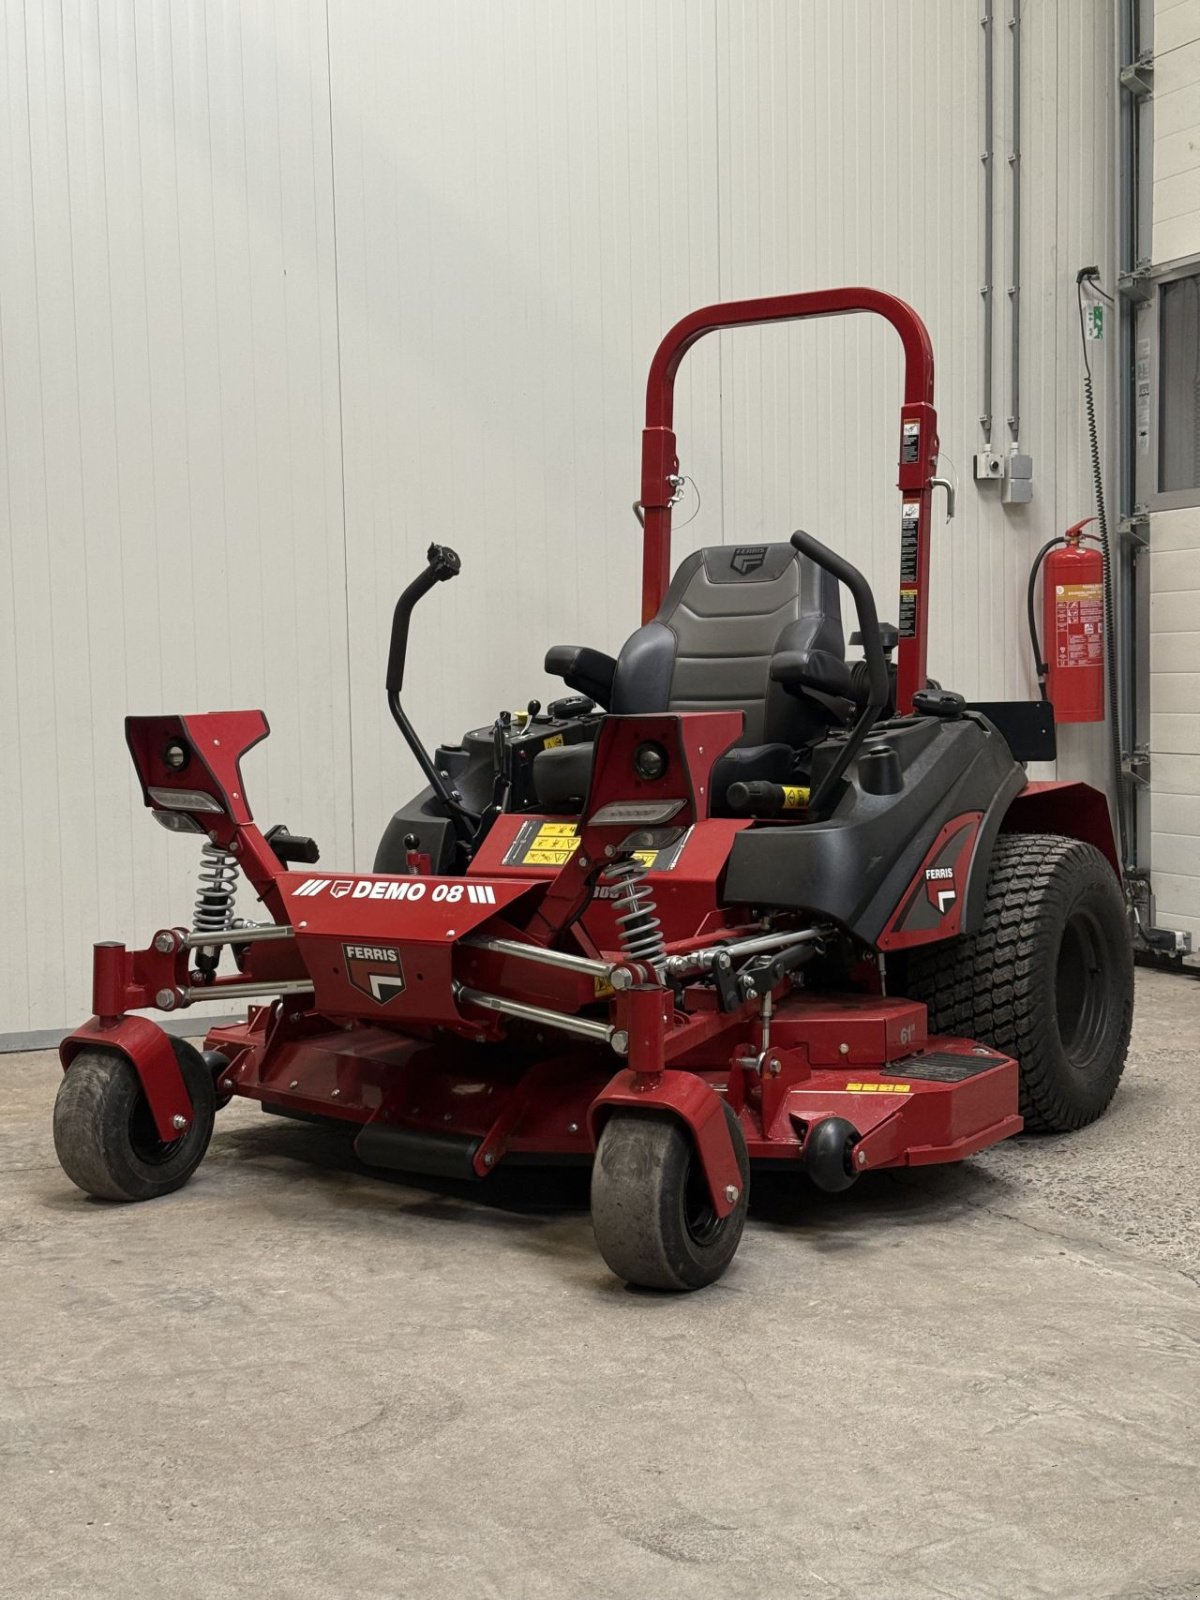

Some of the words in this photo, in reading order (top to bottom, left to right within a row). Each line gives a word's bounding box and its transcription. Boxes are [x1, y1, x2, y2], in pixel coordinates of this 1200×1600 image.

[925, 867, 954, 880] FERRIS
[352, 881, 426, 901] DEMO
[431, 884, 464, 902] 08
[346, 946, 398, 962] FERRIS
